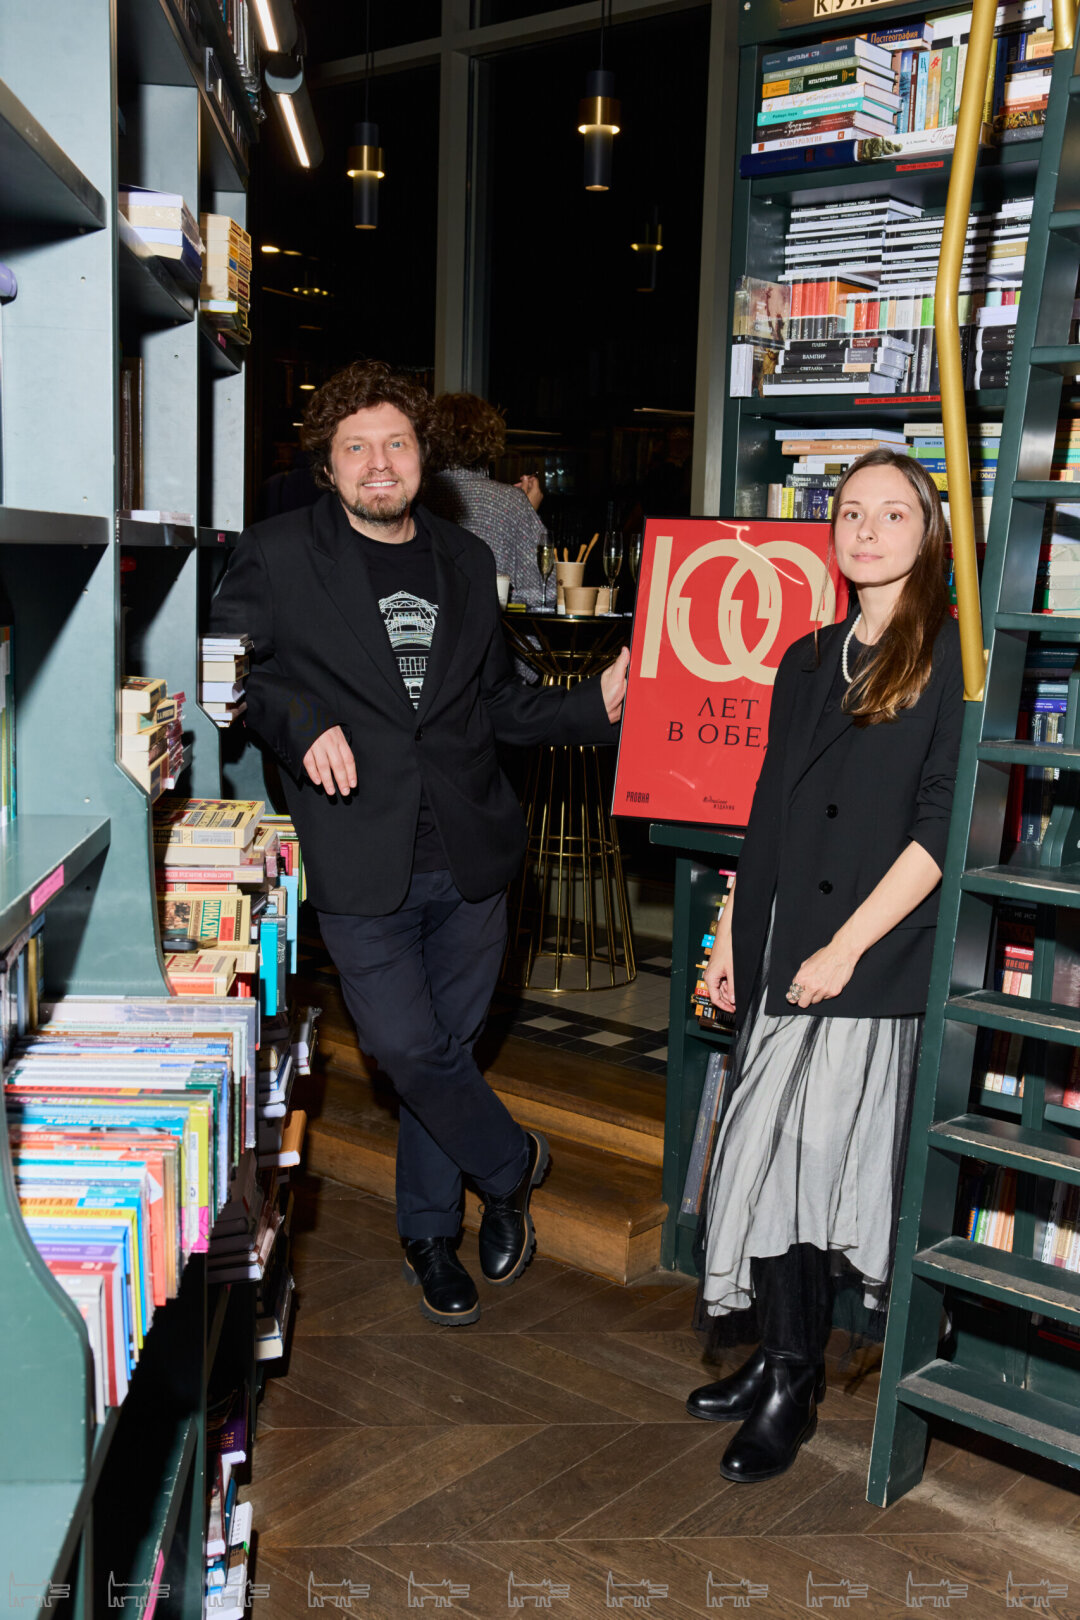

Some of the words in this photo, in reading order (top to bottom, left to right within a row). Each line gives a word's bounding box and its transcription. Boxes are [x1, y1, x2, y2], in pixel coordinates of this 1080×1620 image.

[870, 31, 918, 44] Постгеография
[640, 535, 836, 686] 100
[697, 697, 760, 720] ЛЕТ
[667, 721, 684, 742] В
[698, 723, 769, 751] ОБЕ
[201, 899, 220, 937] АКУНИН
[19, 1197, 74, 1206] АПИТАЛ
